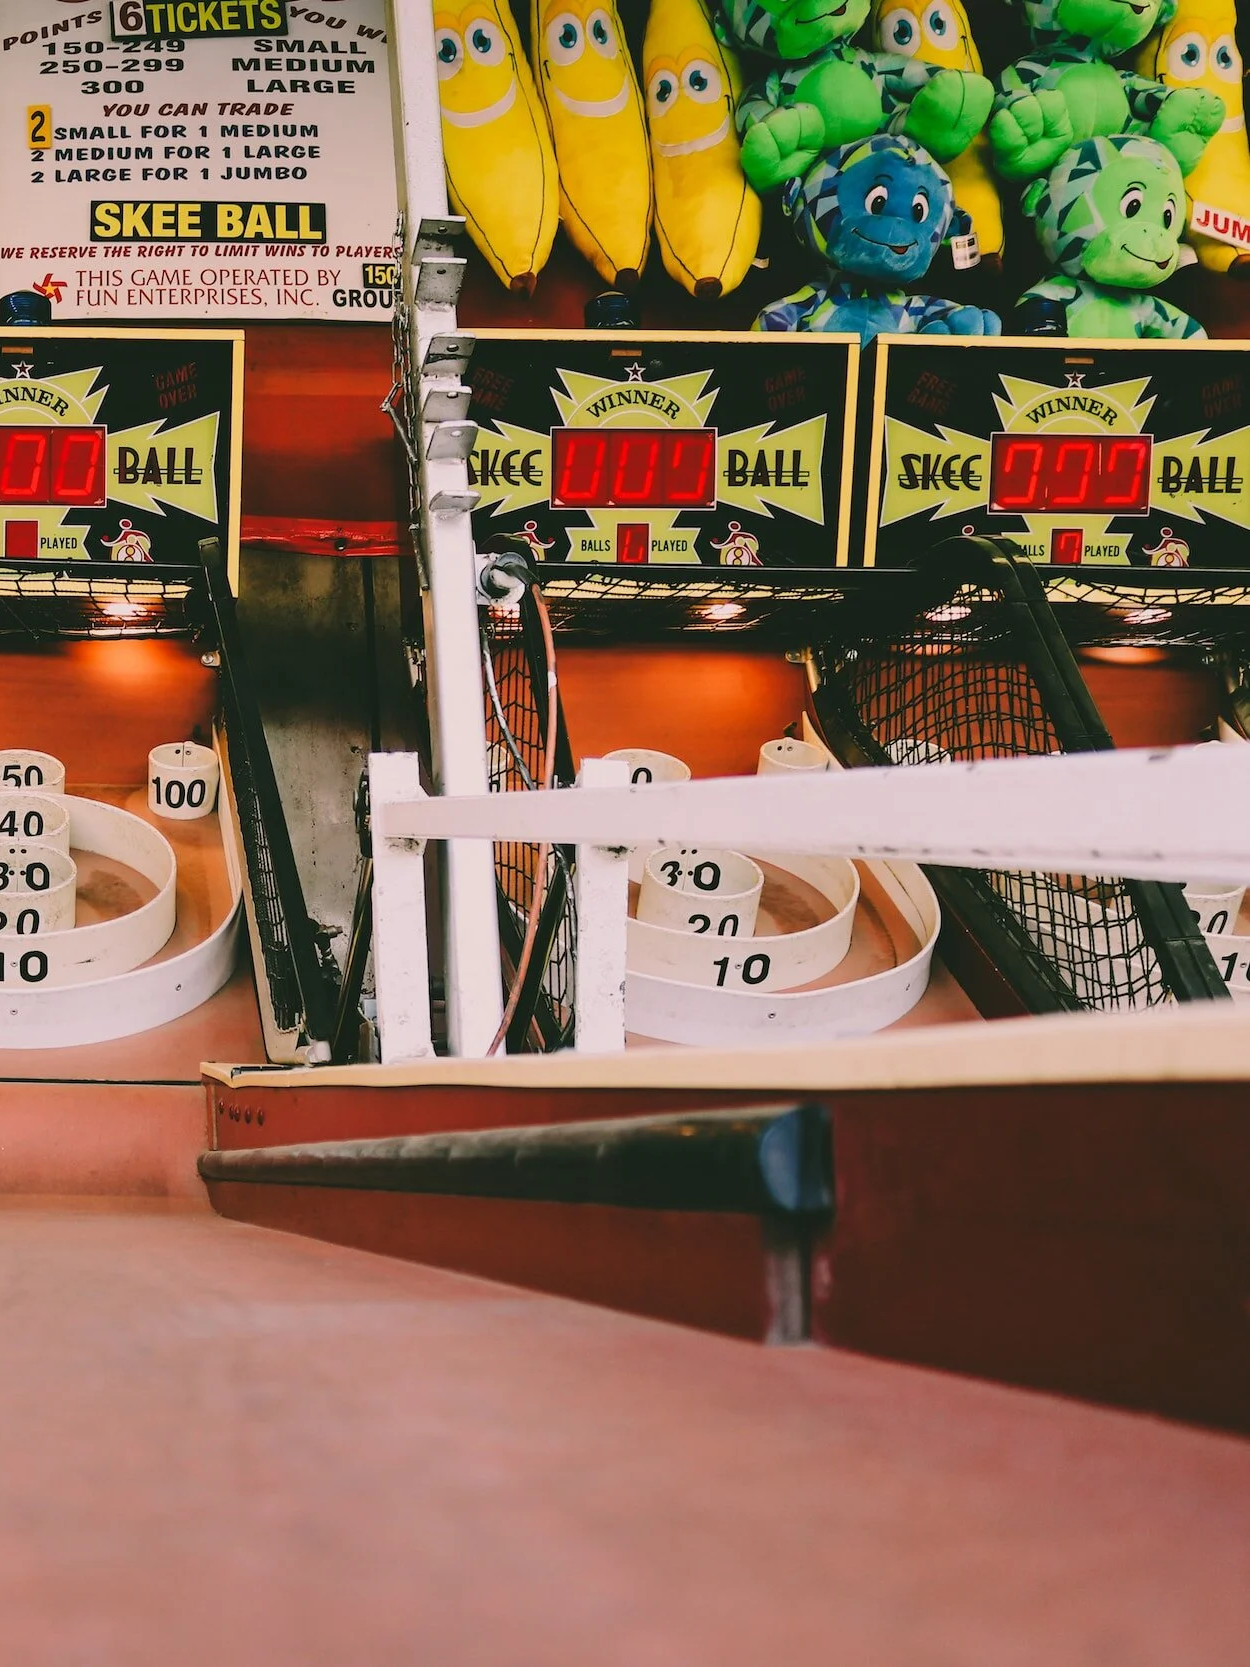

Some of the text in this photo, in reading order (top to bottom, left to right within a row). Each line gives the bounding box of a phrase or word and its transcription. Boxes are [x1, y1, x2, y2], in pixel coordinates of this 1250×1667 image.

[3, 10, 103, 51] POINTS
[119, 1, 144, 31] 6
[145, 0, 282, 34] TICKETS
[290, 6, 348, 29] YOU
[42, 39, 367, 55] 150-249 SMALL
[39, 58, 375, 74] 250-299 MEDIUM
[81, 79, 356, 94] 300 LARGE
[103, 102, 295, 117] YOU CAN TRADE
[30, 110, 319, 142] 2 SMALL FOR 1 MEDIUM
[31, 146, 321, 162] 2 MEDIUM FOR 1 LARGE
[31, 167, 308, 183] 2 LARGE FOR 1 JUMBO
[94, 203, 323, 240] SKEE BALL
[0, 247, 24, 259] WE
[29, 246, 98, 259] RESERVE
[103, 246, 132, 258] THE
[137, 245, 186, 257] RIGHT
[191, 245, 209, 257] TO
[214, 244, 260, 257] LIMIT
[265, 244, 306, 257] WINS
[311, 244, 330, 257] TO
[76, 269, 341, 286] THIS GAME OPERATED BY
[76, 288, 320, 307] FUN ENTERPRISES, INC.
[585, 389, 682, 420] WINNER
[1025, 396, 1118, 426] WINNER
[115, 447, 202, 485] BALL
[724, 449, 810, 487] BALL
[898, 453, 982, 490] SKEE
[1158, 456, 1243, 494] BALL
[40, 537, 78, 549] PLAYED
[581, 540, 611, 551] BALLS
[651, 540, 688, 551] PLAYED
[1020, 545, 1045, 556] ALLS
[1084, 546, 1120, 557] PLAYED
[2, 765, 44, 788] 50
[152, 777, 206, 809] 100
[660, 861, 721, 891] 30
[688, 914, 739, 937] 20
[713, 953, 771, 987] 10
